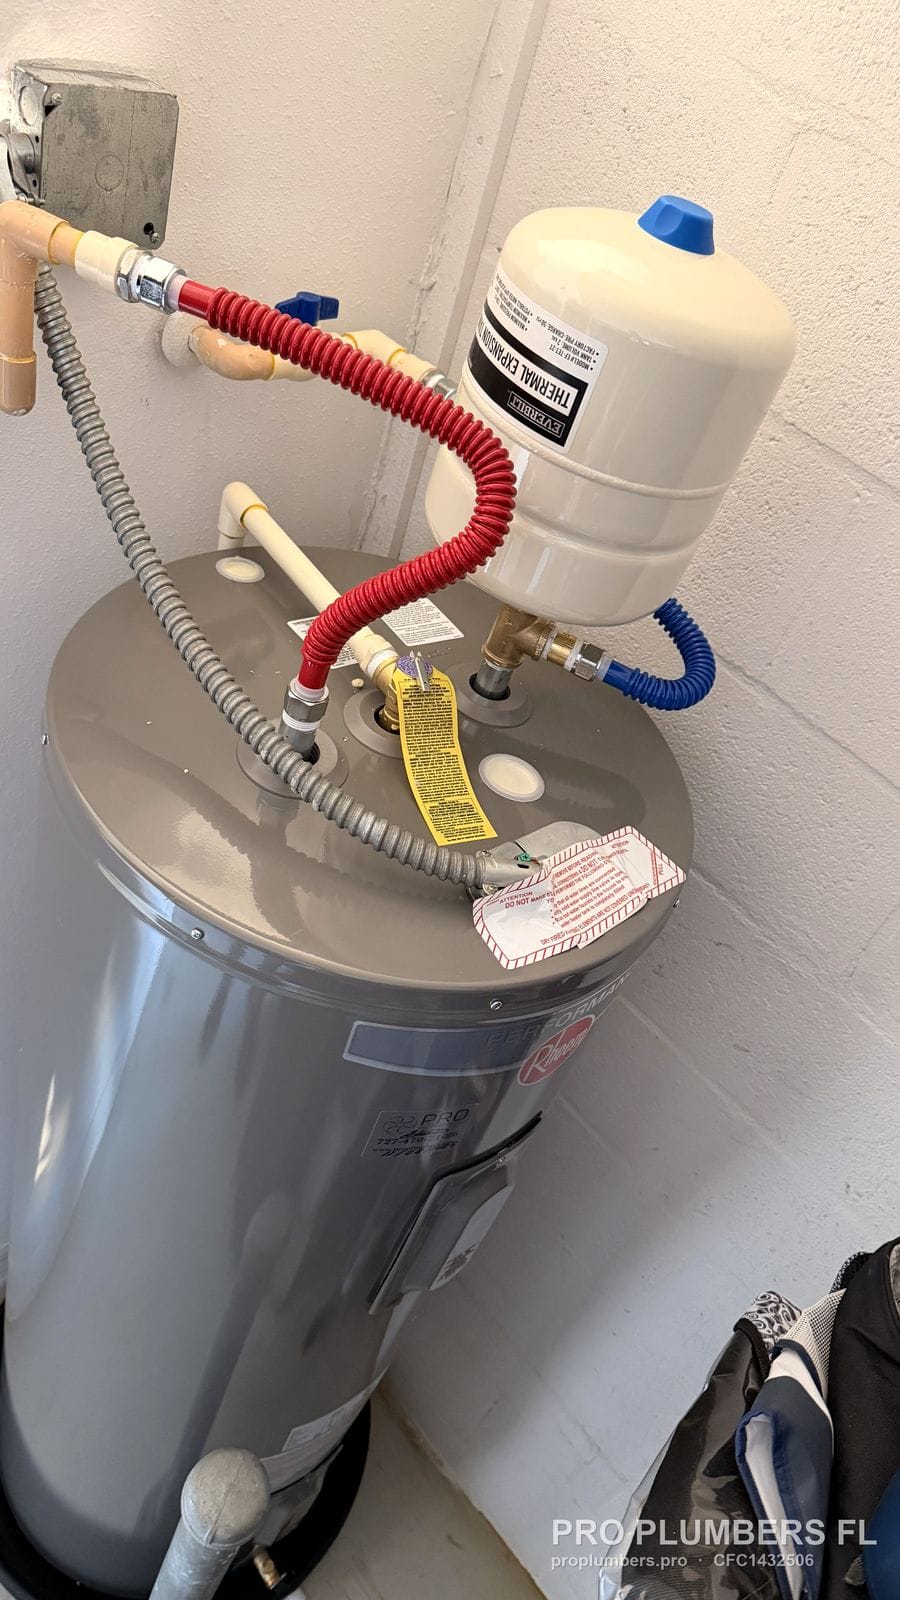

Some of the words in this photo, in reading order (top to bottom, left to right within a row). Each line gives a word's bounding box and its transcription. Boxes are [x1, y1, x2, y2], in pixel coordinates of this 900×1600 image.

[481, 326, 519, 375] EXPANSION
[574, 341, 596, 356] FACTORY
[579, 352, 593, 363] TANK
[520, 365, 571, 408] THERMAL
[509, 396, 562, 433] EVERBILT
[499, 890, 533, 904] ATTENTION
[516, 897, 529, 906] NOT
[524, 1026, 588, 1081] Rheem
[421, 1108, 470, 1126] PRO
